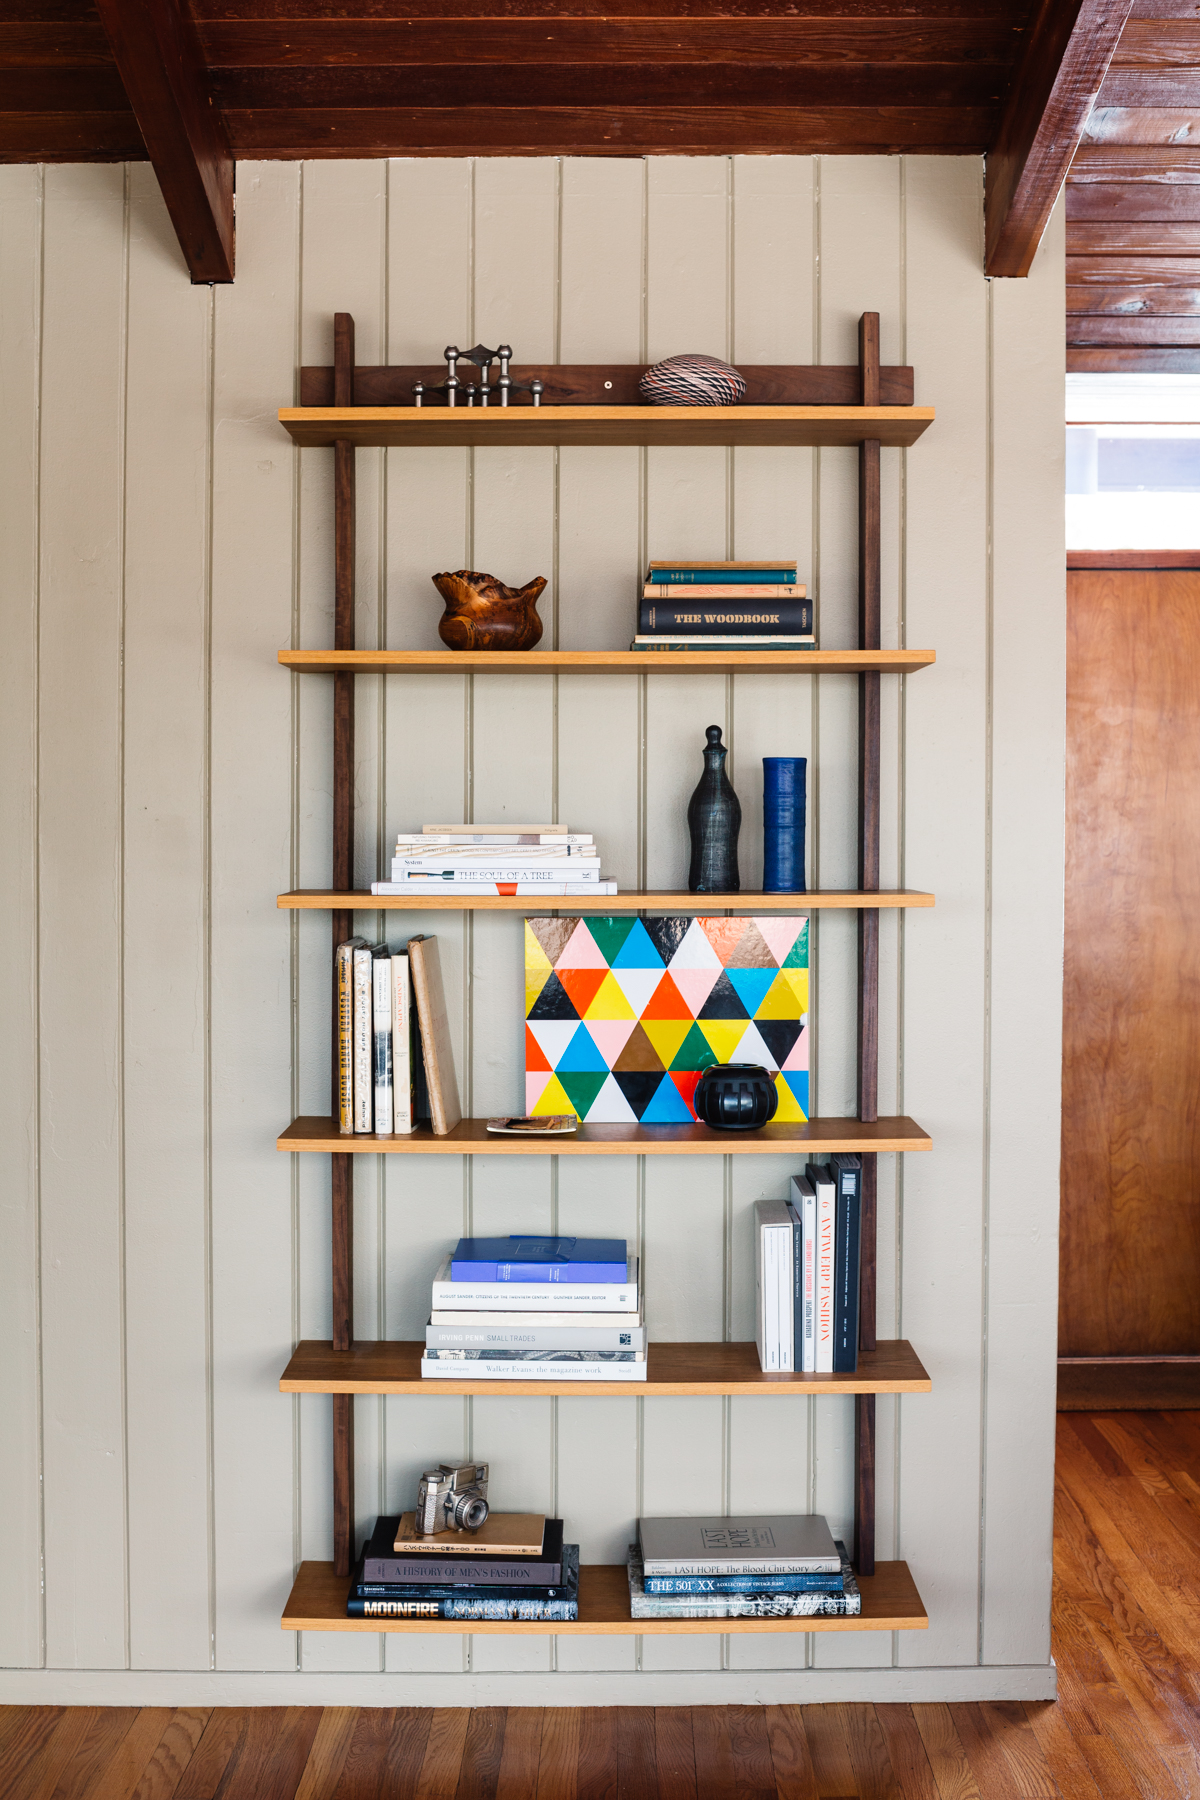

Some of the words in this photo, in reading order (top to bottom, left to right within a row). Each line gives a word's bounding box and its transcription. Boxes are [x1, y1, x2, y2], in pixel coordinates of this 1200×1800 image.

[674, 614, 702, 624] THE
[703, 614, 780, 624] WOODBOOK
[458, 871, 479, 880] THE
[479, 871, 505, 880] SOUL
[506, 871, 520, 880] OF
[520, 871, 530, 880] A
[530, 871, 554, 880] TREE
[341, 991, 350, 1032] WESTERN
[341, 1075, 351, 1108] HOUSES
[821, 1215, 831, 1281] ANTWERP
[820, 1287, 830, 1342] FASHION
[486, 1365, 510, 1373] Walker
[550, 1367, 583, 1375] magazine
[704, 1528, 728, 1548] LAST
[728, 1528, 752, 1548] HOPE
[395, 1566, 402, 1576] A
[403, 1566, 443, 1576] HISTORY
[444, 1567, 457, 1577] OF
[459, 1567, 488, 1578] MEN'S
[490, 1569, 530, 1578] FASHION
[674, 1566, 695, 1574] LAST
[697, 1565, 723, 1574] HOPE:
[726, 1565, 740, 1574] The
[742, 1565, 766, 1573] Blood
[768, 1564, 785, 1573] Chit
[788, 1564, 810, 1573] Story
[647, 1580, 674, 1591] THE
[697, 1580, 715, 1591] XX
[363, 1601, 440, 1618] MOONFIRE
[453, 1606, 504, 1616] NORMAN
[508, 1607, 552, 1617] MAILER
